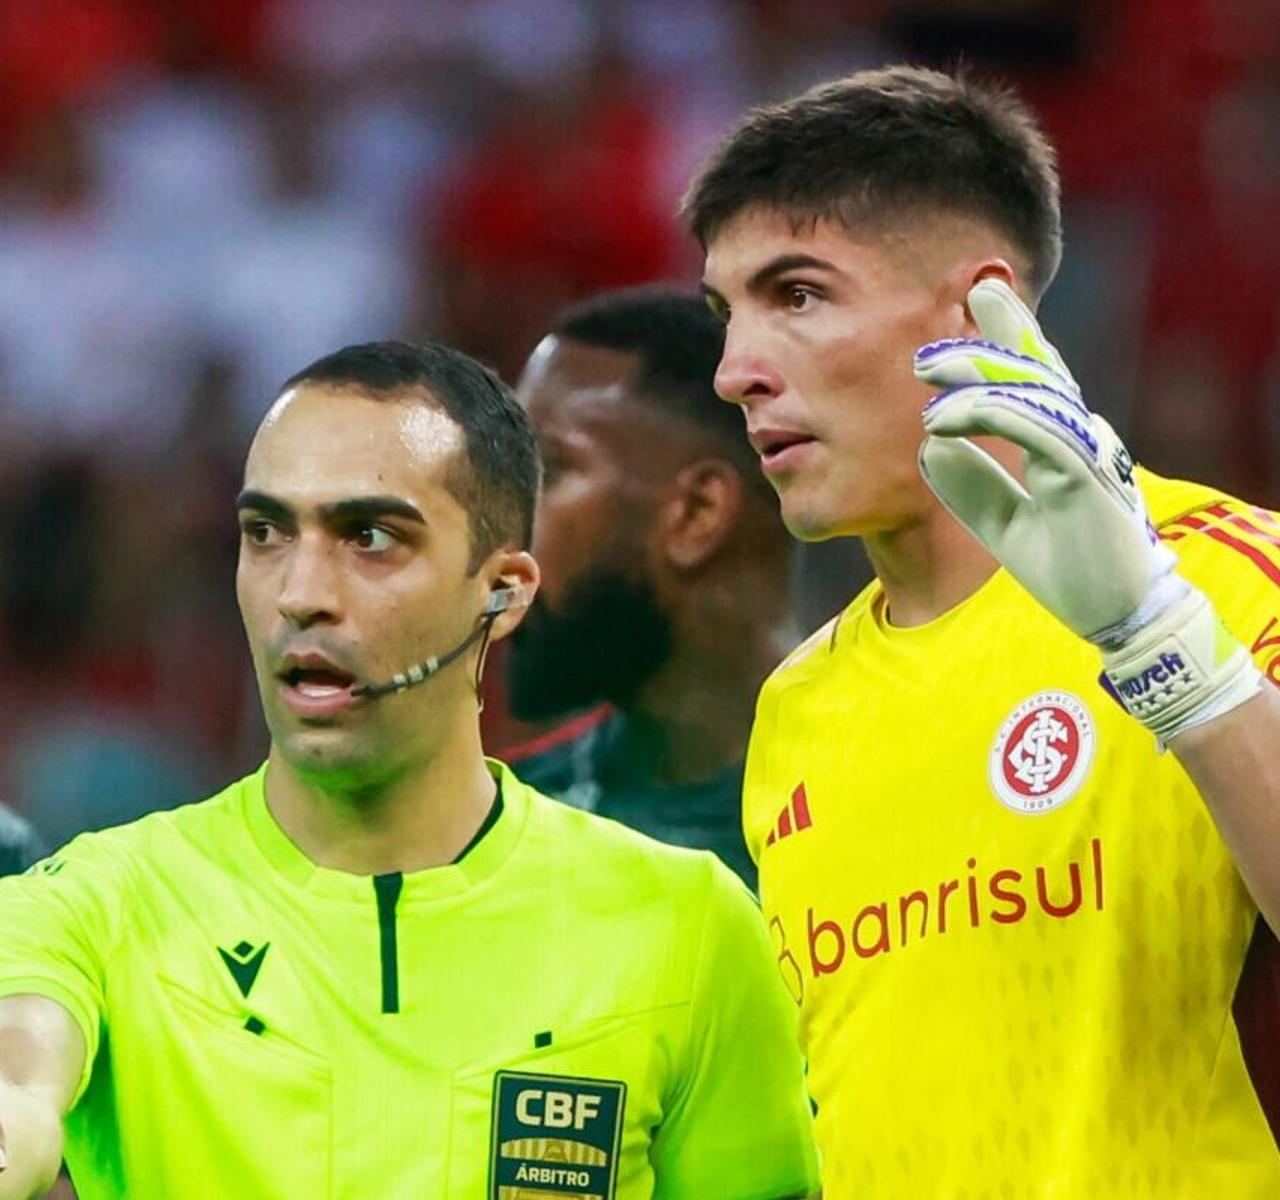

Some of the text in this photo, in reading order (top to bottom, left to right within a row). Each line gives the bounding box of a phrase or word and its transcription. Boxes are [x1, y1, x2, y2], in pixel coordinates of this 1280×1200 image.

[806, 838, 1104, 978] banrisul
[515, 1088, 601, 1130] CBF
[516, 1163, 590, 1187] ÁRBITRO
